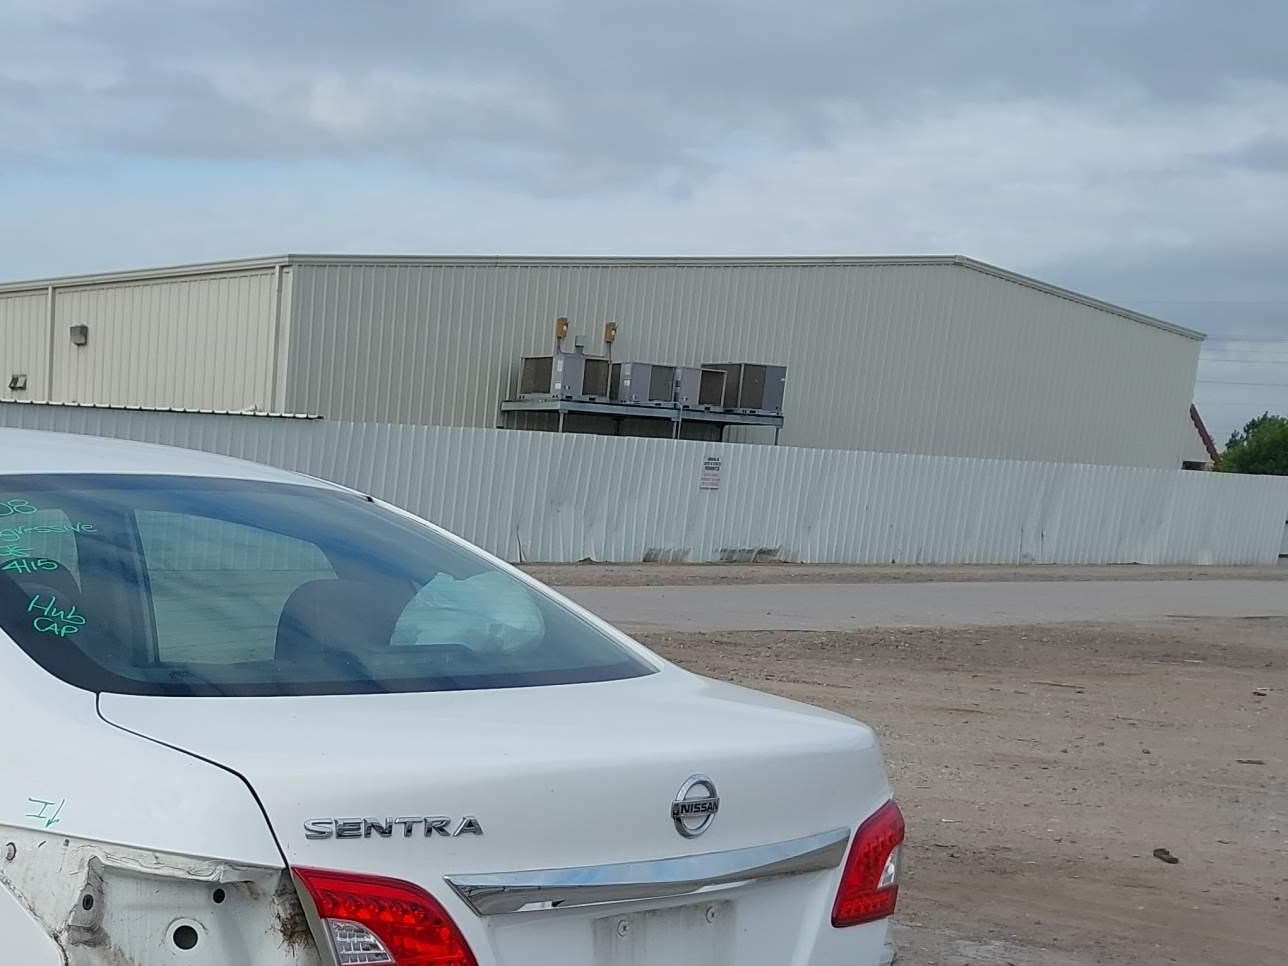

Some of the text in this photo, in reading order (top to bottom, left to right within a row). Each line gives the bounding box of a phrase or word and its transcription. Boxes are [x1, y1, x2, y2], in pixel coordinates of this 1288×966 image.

[27, 594, 86, 625] Hub
[680, 800, 719, 814] NISSAN
[303, 815, 484, 840] SENTRA
